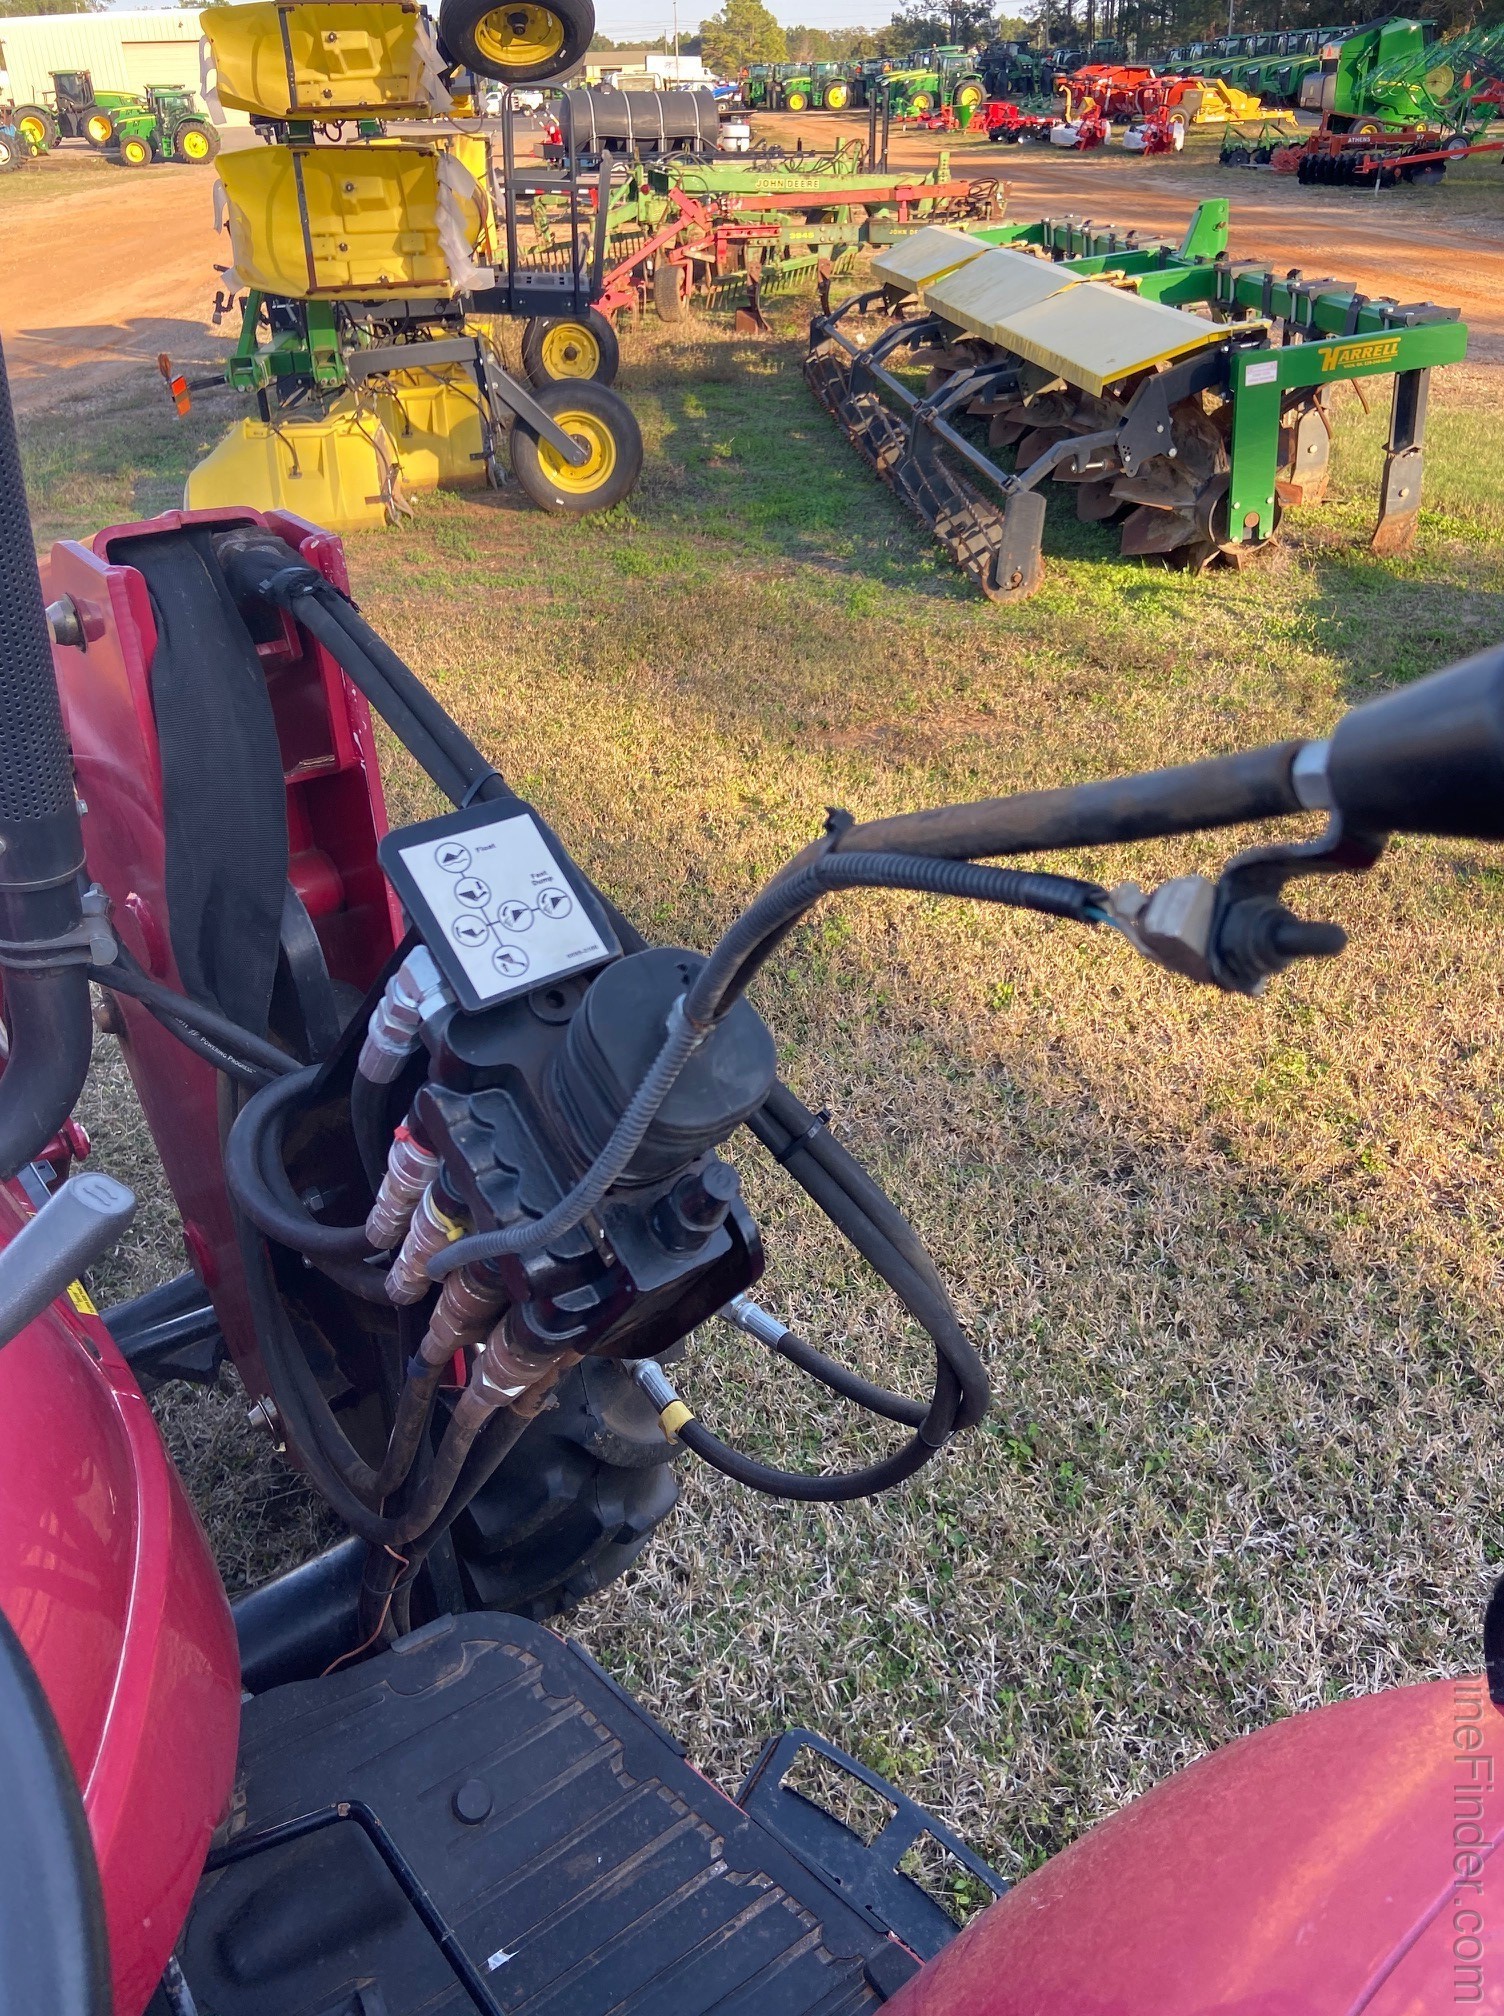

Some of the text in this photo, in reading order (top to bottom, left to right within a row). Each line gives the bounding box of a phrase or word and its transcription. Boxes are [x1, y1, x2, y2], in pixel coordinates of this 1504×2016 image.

[756, 179, 819, 188] JOHN DEERE
[1318, 337, 1401, 372] HARRELL
[200, 1037, 228, 1058] POWERING
